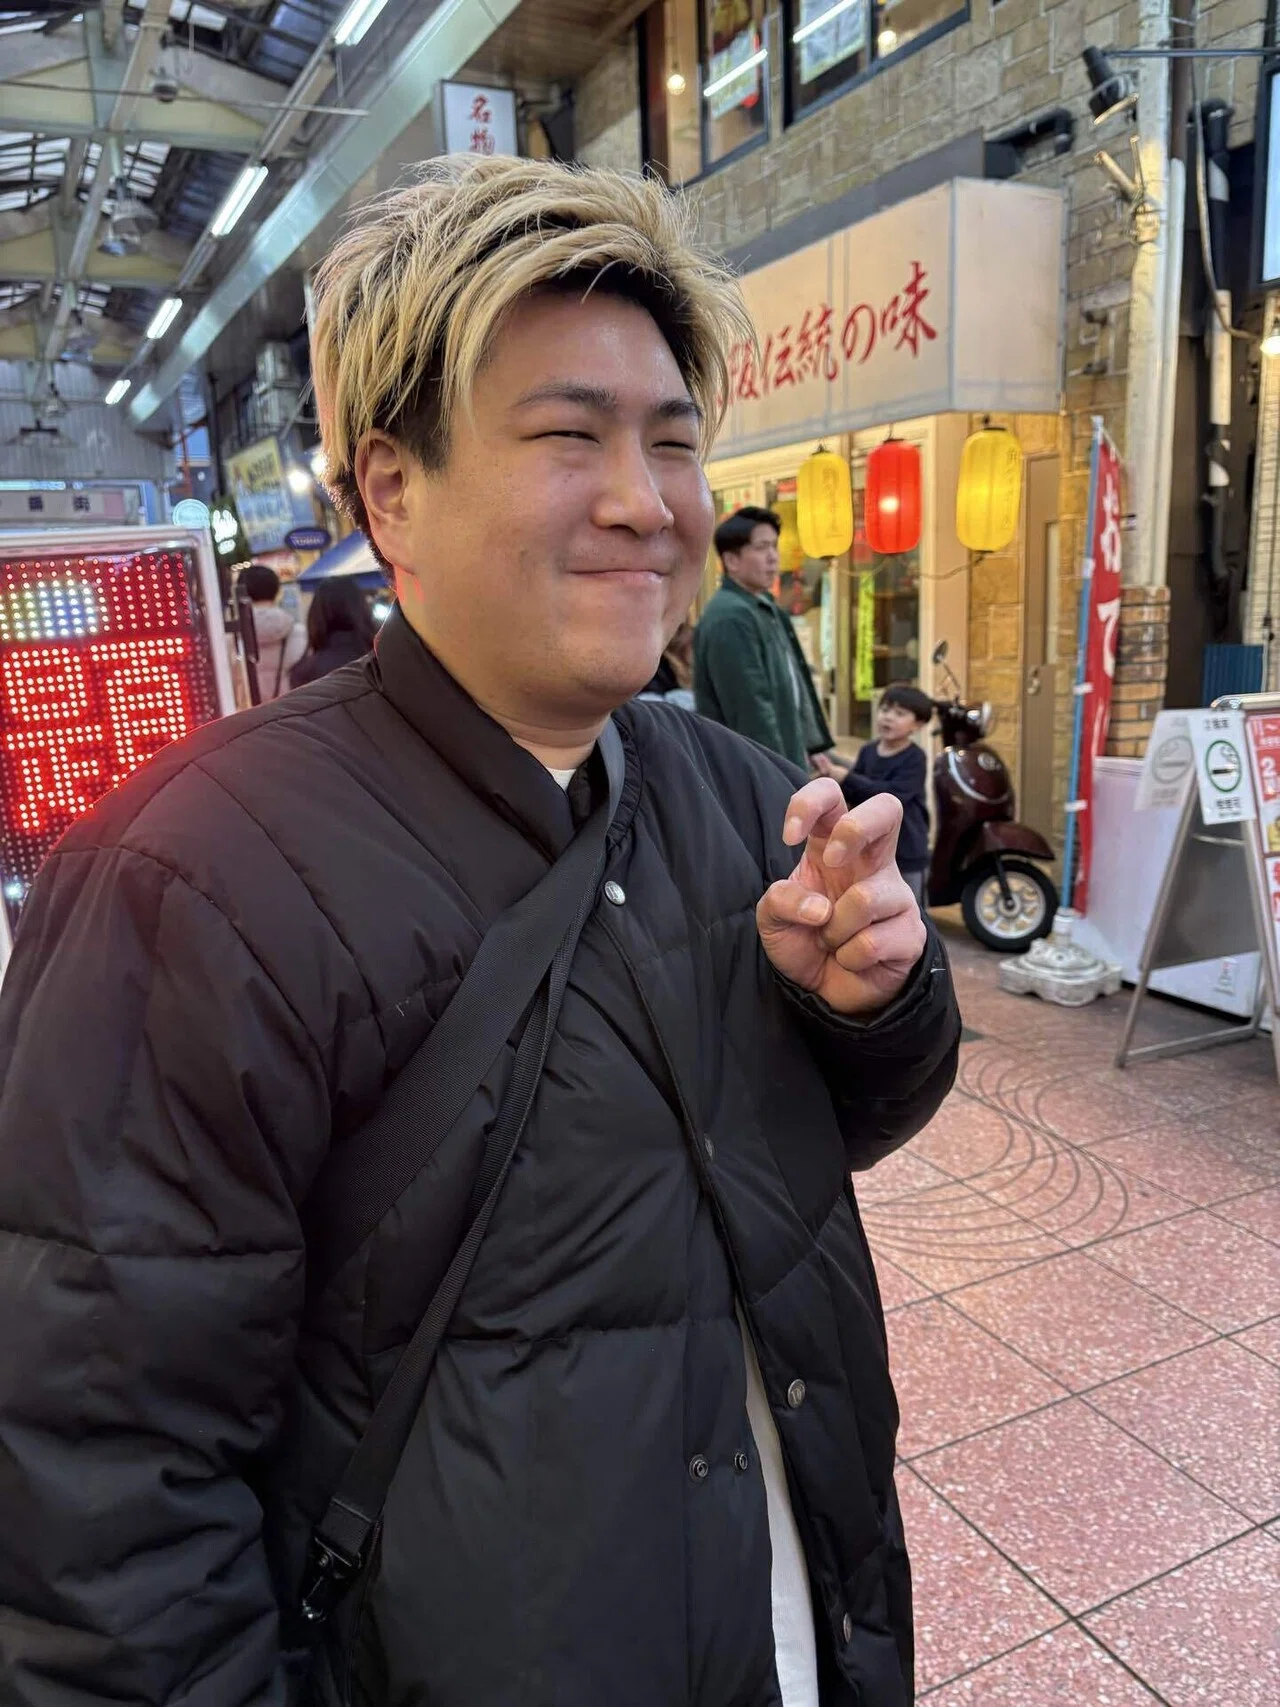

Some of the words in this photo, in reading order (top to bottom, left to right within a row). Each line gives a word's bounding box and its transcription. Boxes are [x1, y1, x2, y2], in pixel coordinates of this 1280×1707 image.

[717, 261, 937, 408] 阪伝統の味
